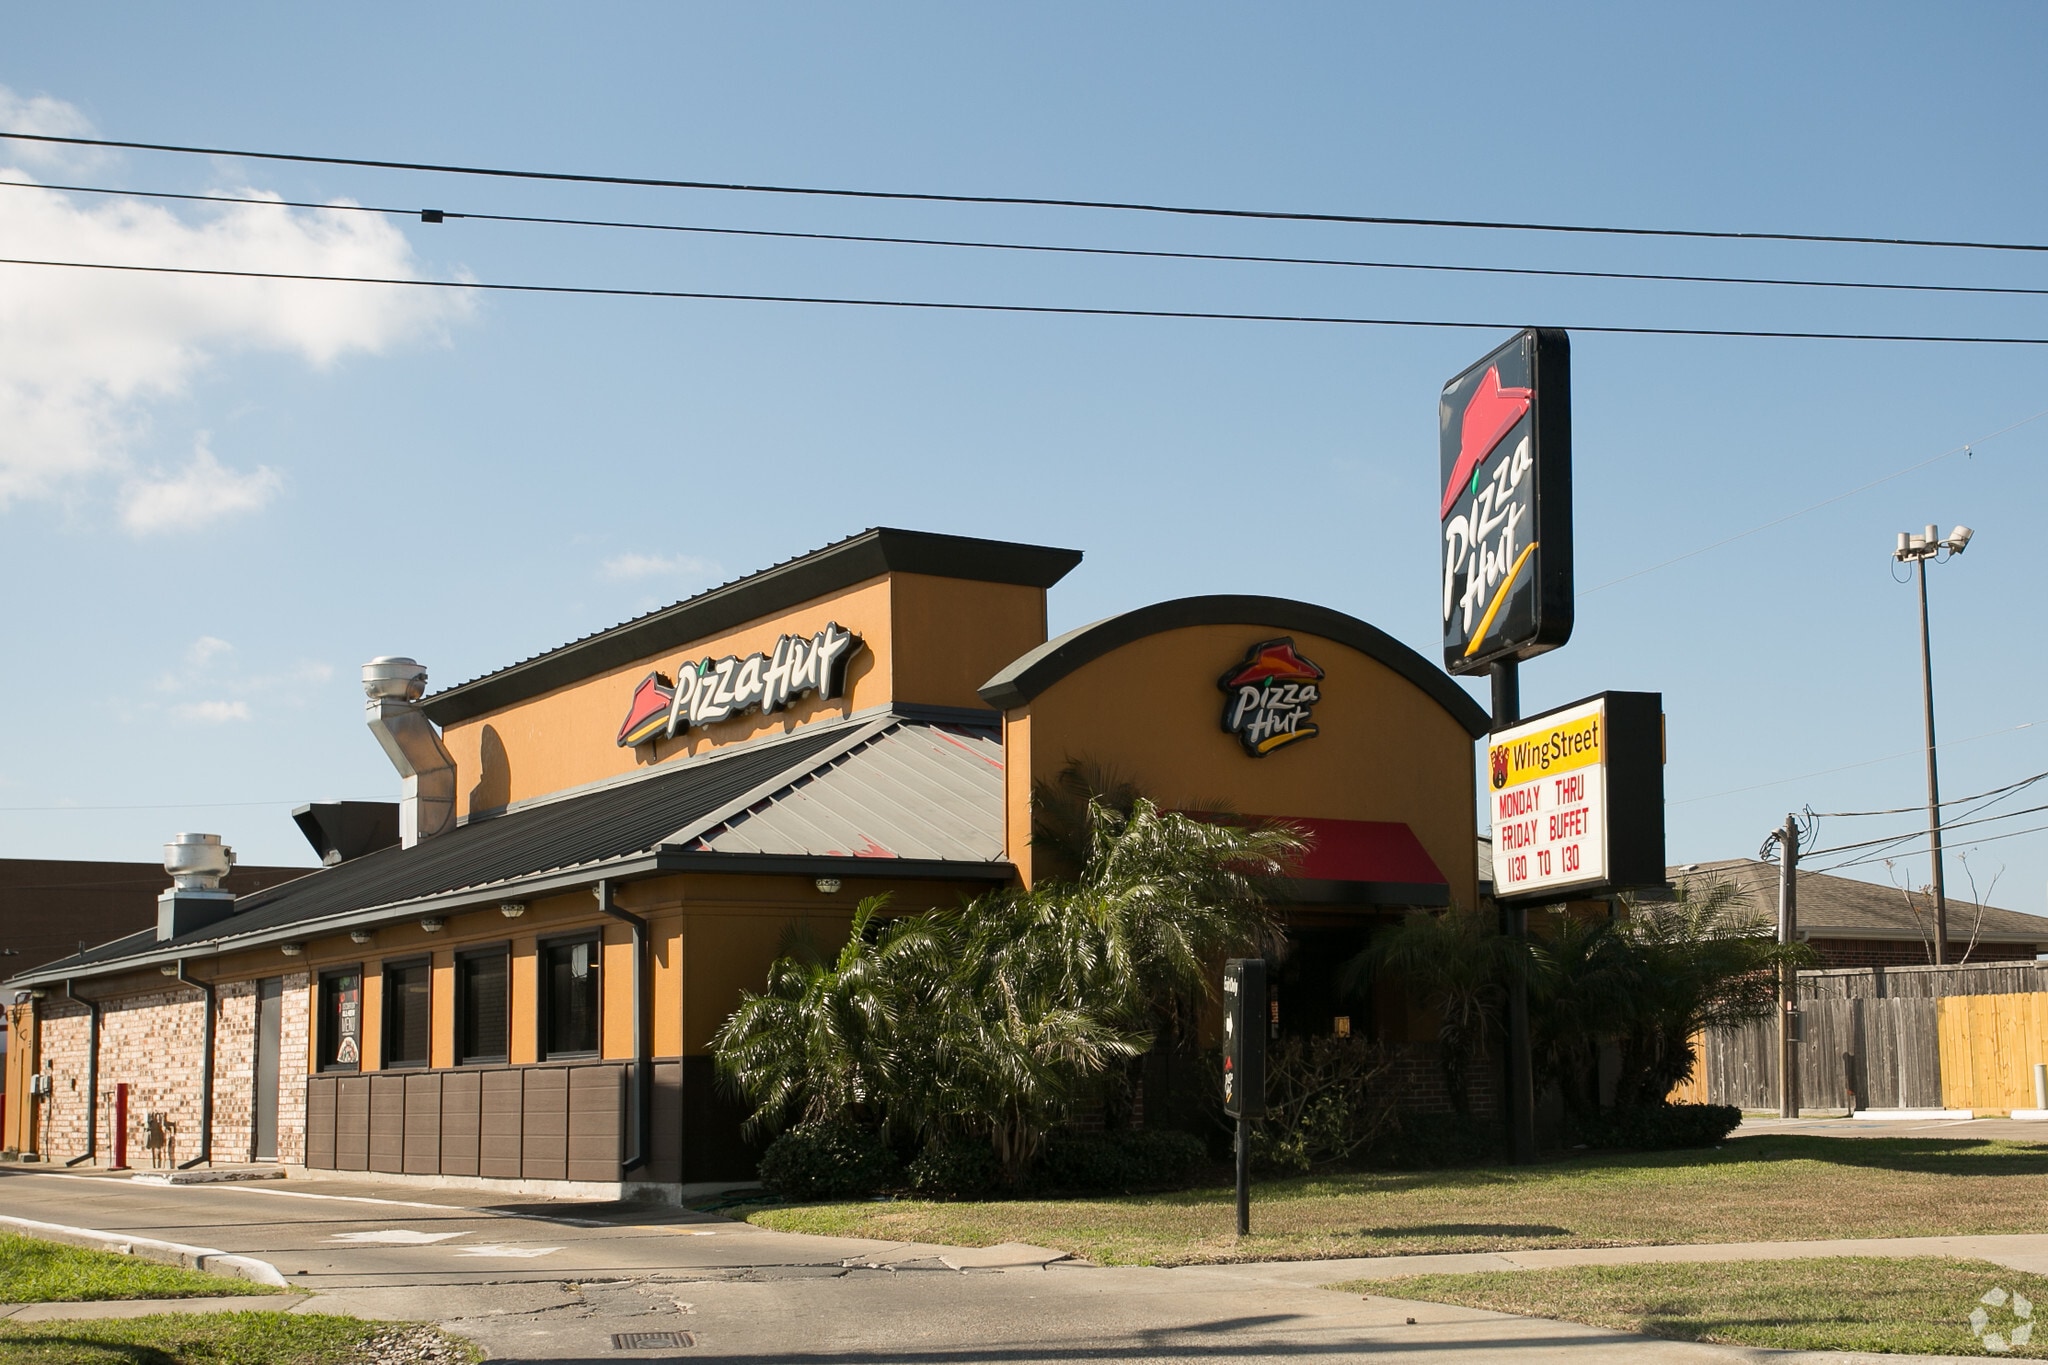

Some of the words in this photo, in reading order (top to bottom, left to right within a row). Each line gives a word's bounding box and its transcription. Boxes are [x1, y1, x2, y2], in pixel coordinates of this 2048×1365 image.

[1444, 436, 1533, 621] Pizza
[1460, 502, 1526, 634] Hut
[667, 657, 763, 732] Pizza
[762, 627, 848, 710] Hut
[1233, 678, 1318, 729] Pizza
[1247, 706, 1309, 742] Hut
[1513, 721, 1599, 771] WingStreet
[1499, 785, 1541, 820] MONDAY
[1555, 774, 1585, 805] THRU
[1502, 819, 1538, 851] FRIDAY
[1549, 807, 1589, 841] BUFFET
[1507, 855, 1527, 883] 1130
[1537, 850, 1551, 876] TO
[1561, 844, 1580, 873] 130
